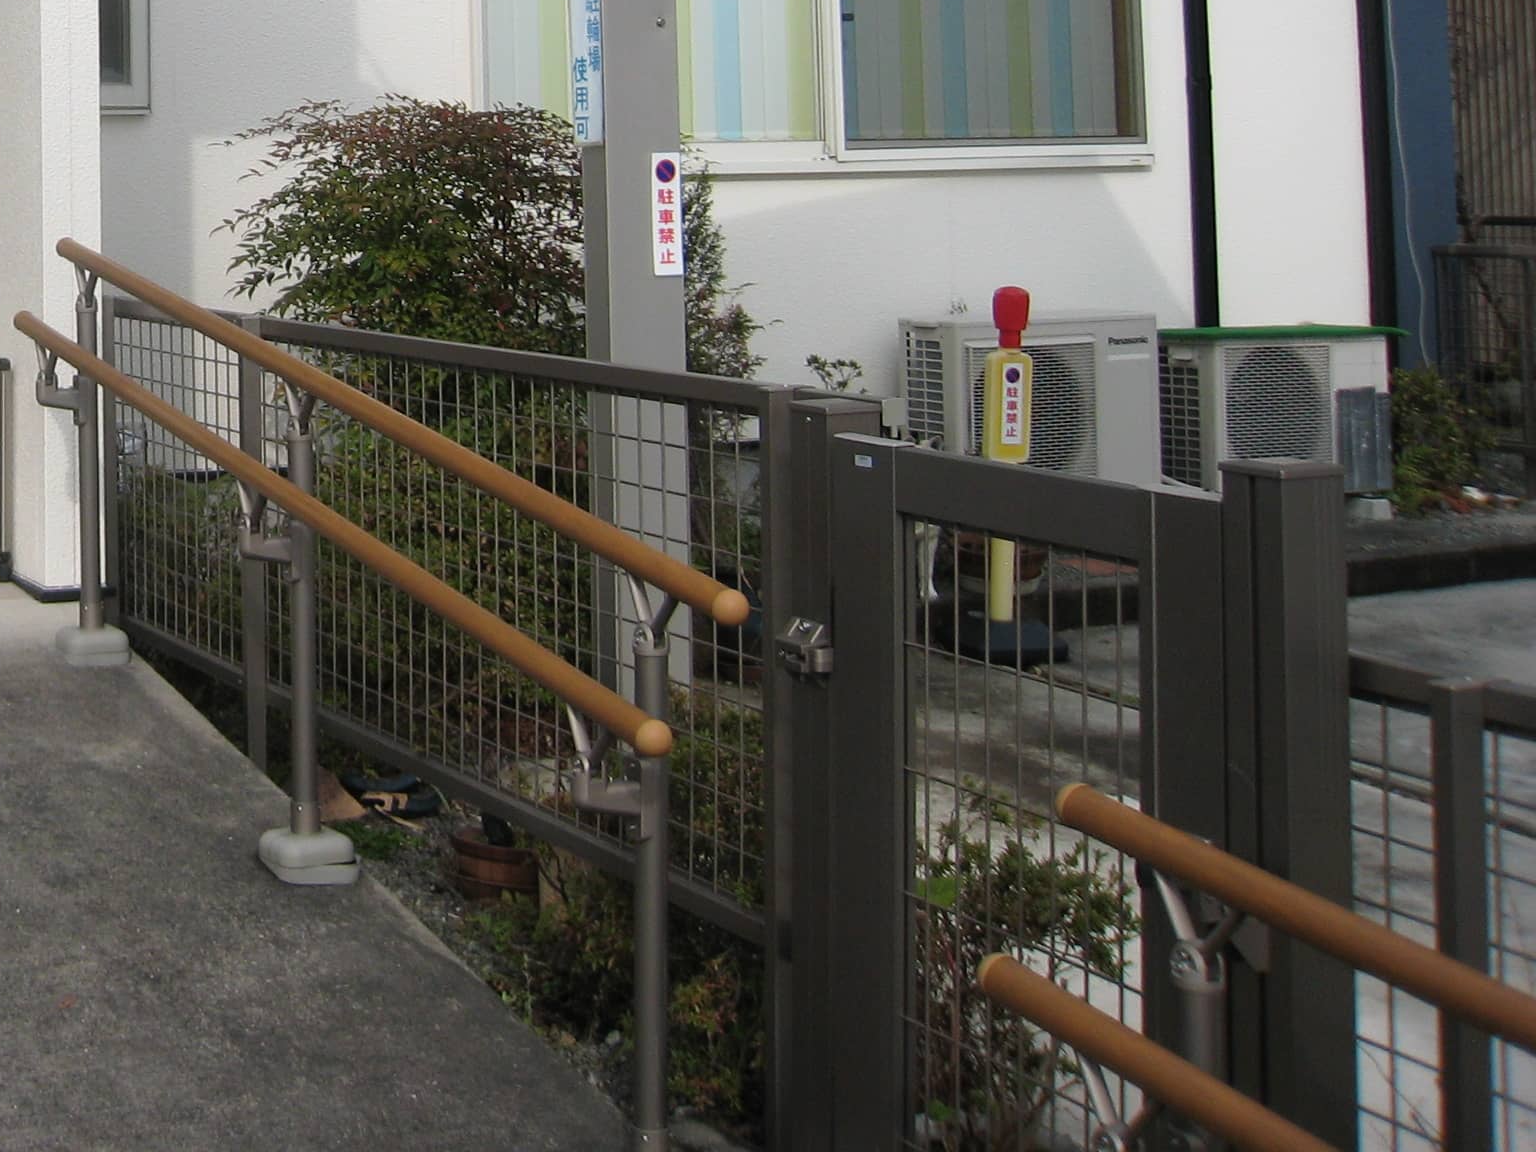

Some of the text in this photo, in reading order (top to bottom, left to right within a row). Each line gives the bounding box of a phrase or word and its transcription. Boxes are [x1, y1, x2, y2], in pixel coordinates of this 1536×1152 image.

[573, 56, 590, 139] 使用可
[657, 188, 677, 265] 駐車禁止
[1107, 336, 1149, 345] Panasonic
[1005, 387, 1018, 438] 駐車禁止
